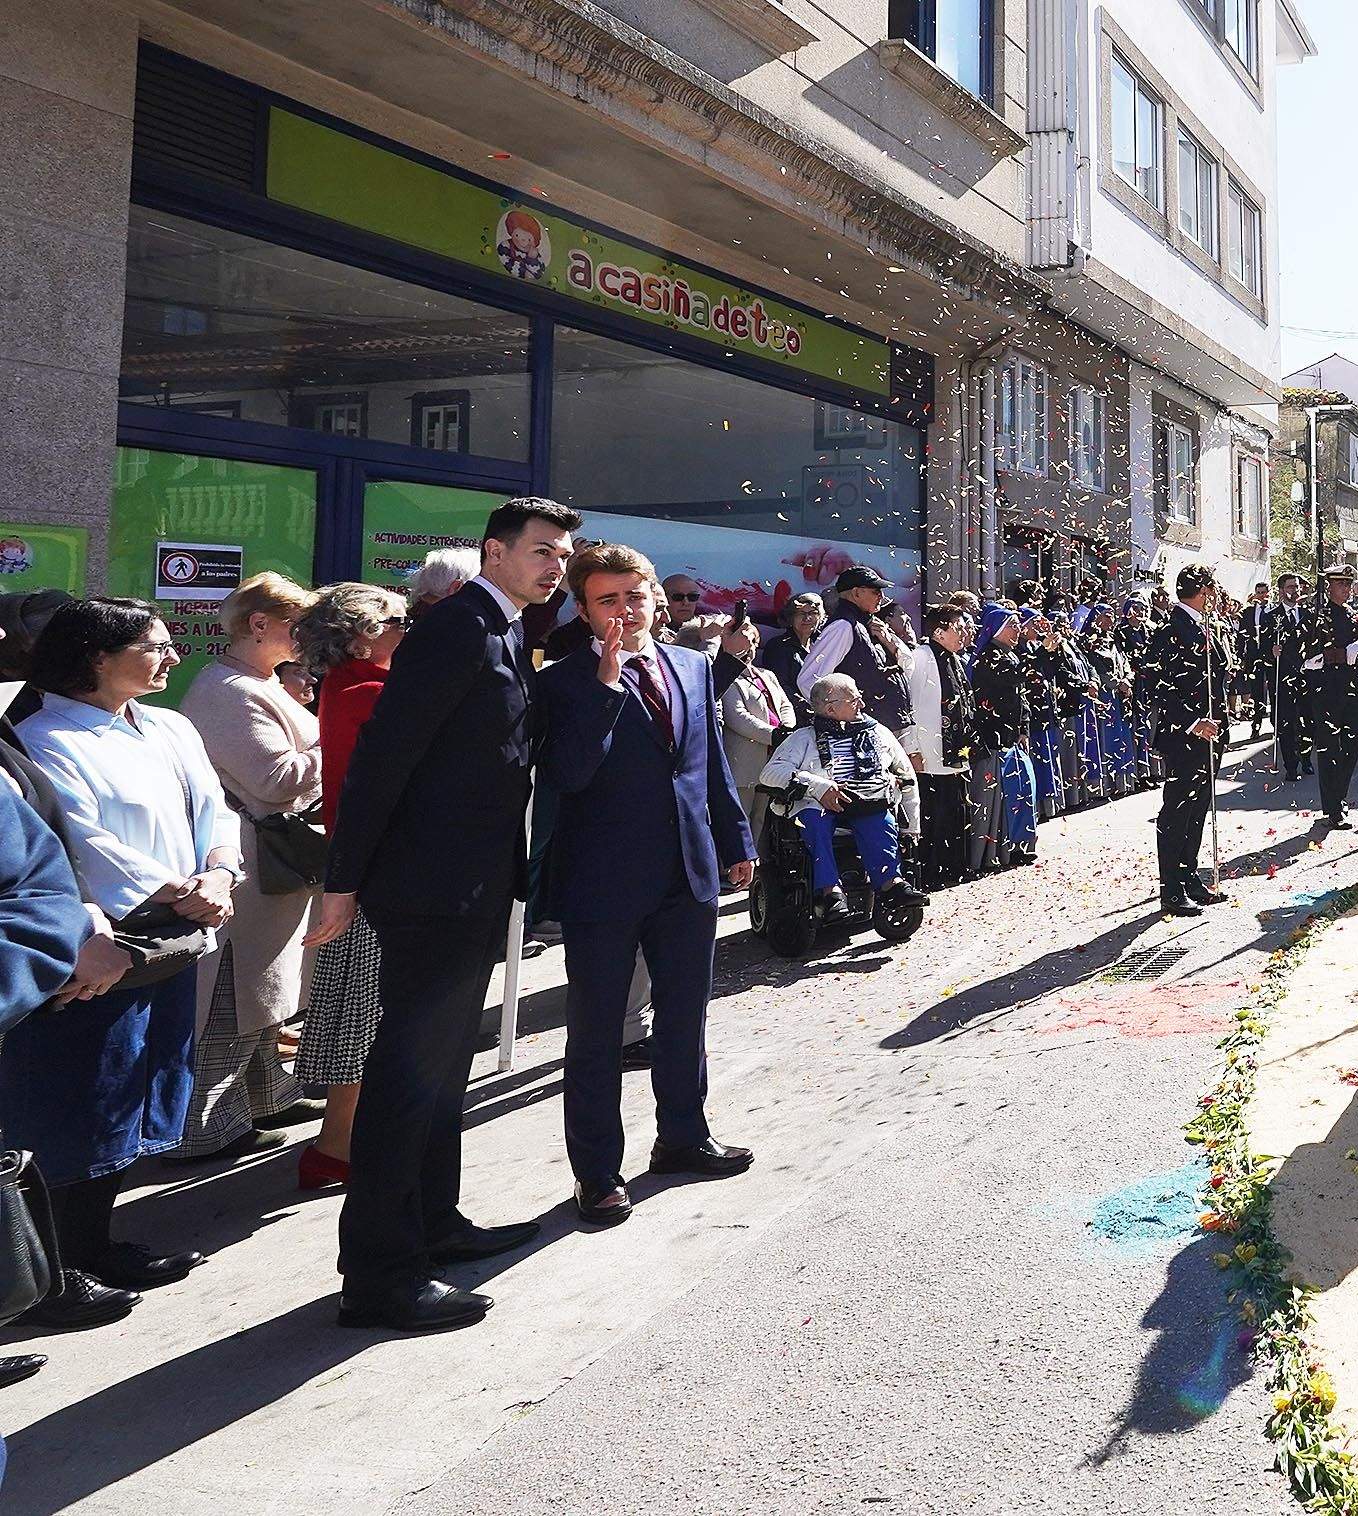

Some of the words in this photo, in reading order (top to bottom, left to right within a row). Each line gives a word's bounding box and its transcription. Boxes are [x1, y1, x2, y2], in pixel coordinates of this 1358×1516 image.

[374, 532, 427, 547] ACTIVIDADES
[216, 570, 238, 578] padres
[192, 623, 202, 636] A
[205, 622, 228, 637] VIE
